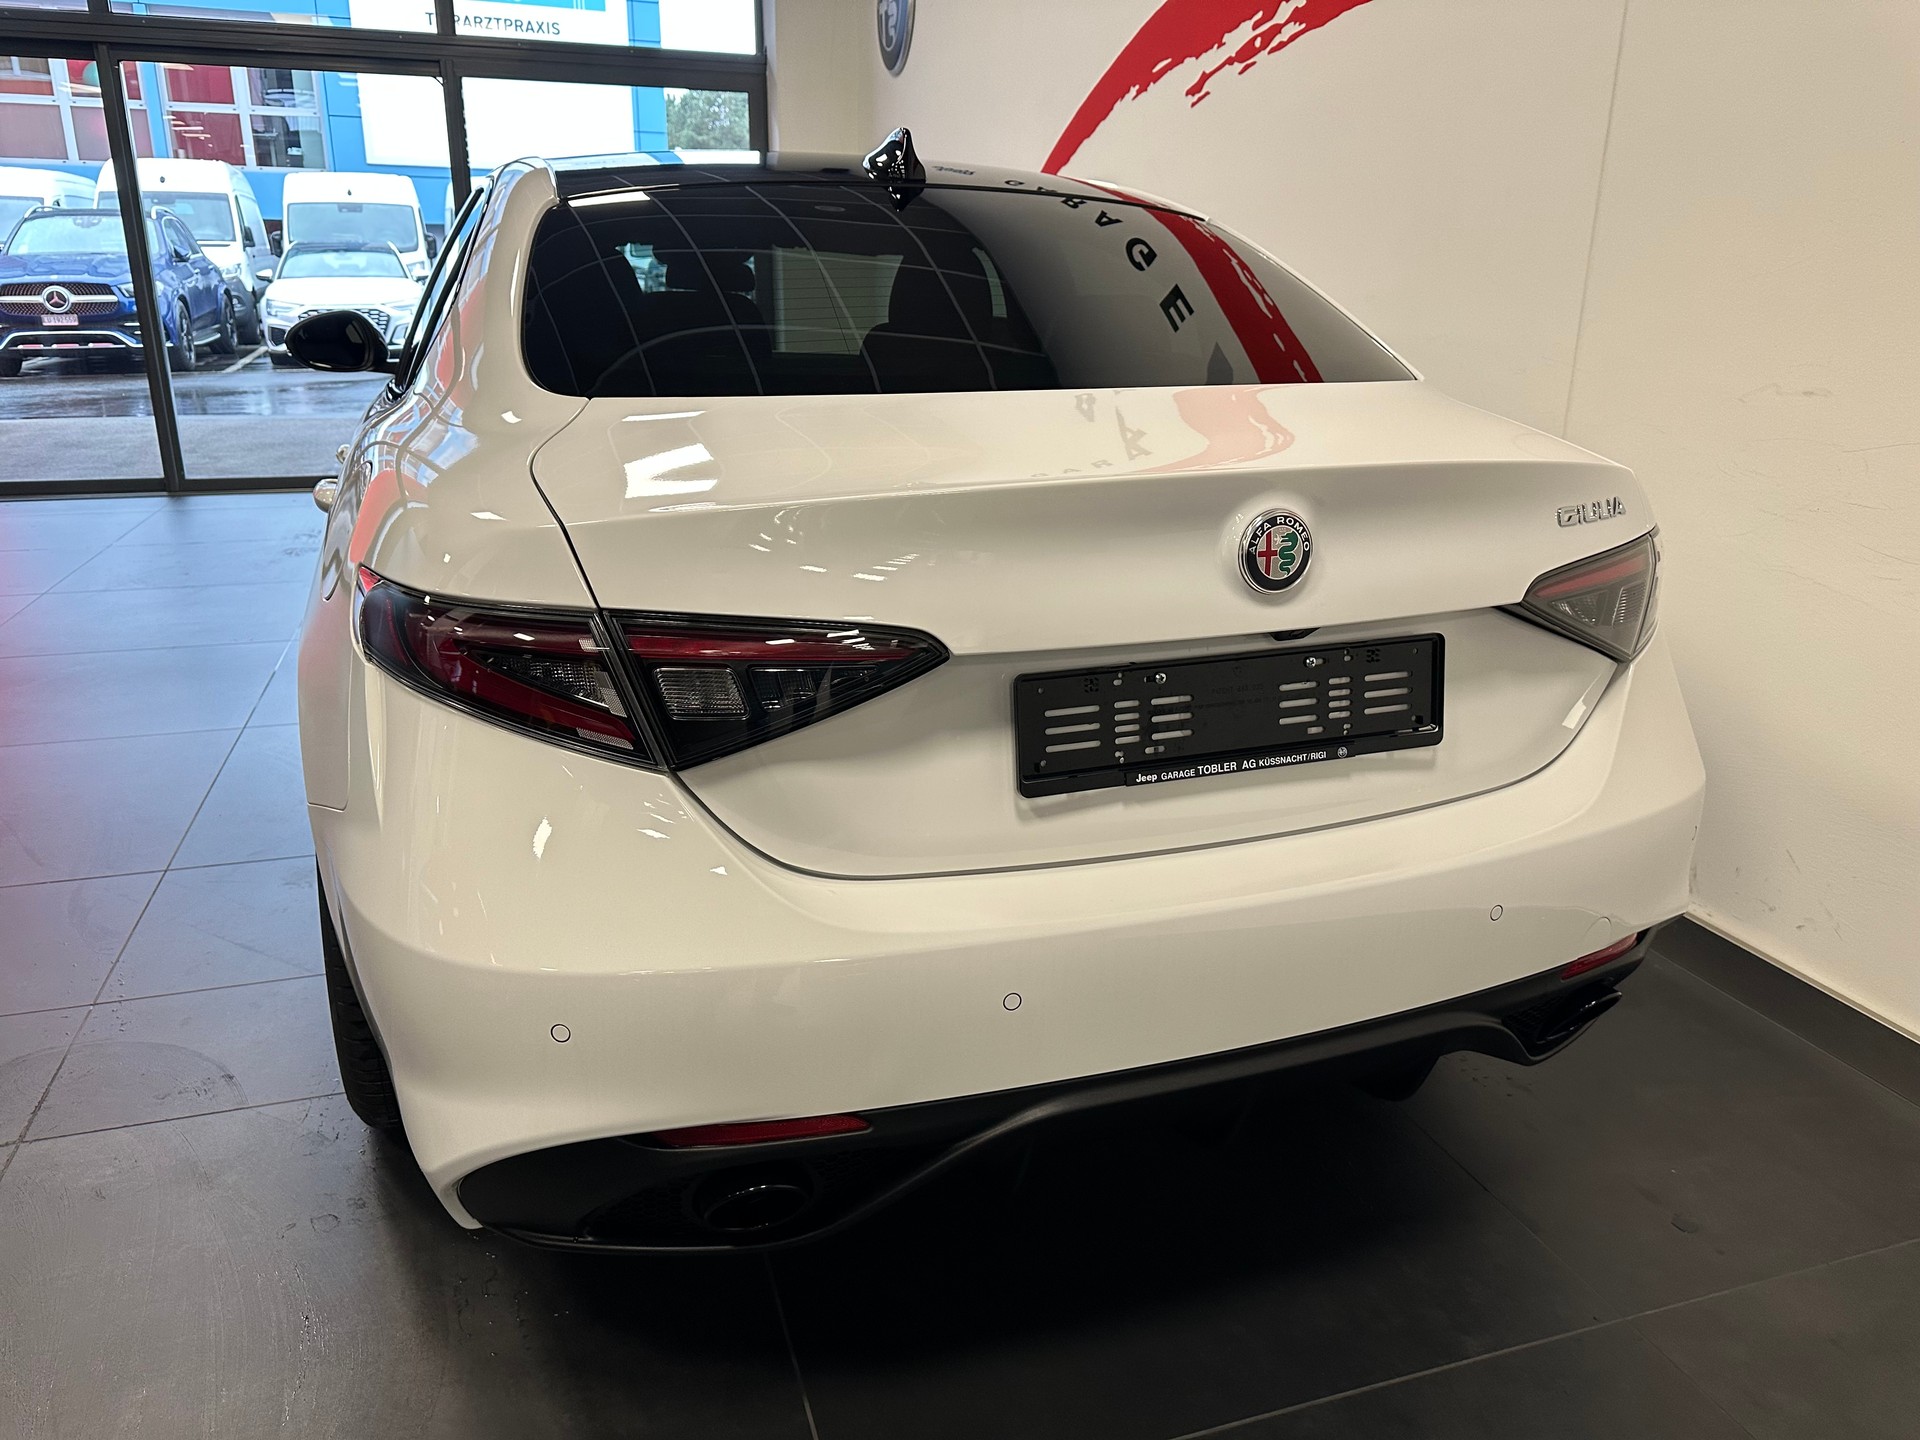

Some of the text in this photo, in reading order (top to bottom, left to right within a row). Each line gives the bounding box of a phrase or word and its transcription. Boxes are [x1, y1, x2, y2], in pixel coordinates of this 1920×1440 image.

[425, 11, 560, 35] TRARZTPRAXIS
[1557, 496, 1626, 527] GIULIA
[1249, 516, 1310, 555] ALFA ROMEO
[1135, 751, 1327, 784] Jeep GARAGE TOBLER AG KÜSSNACHT/RIGI
